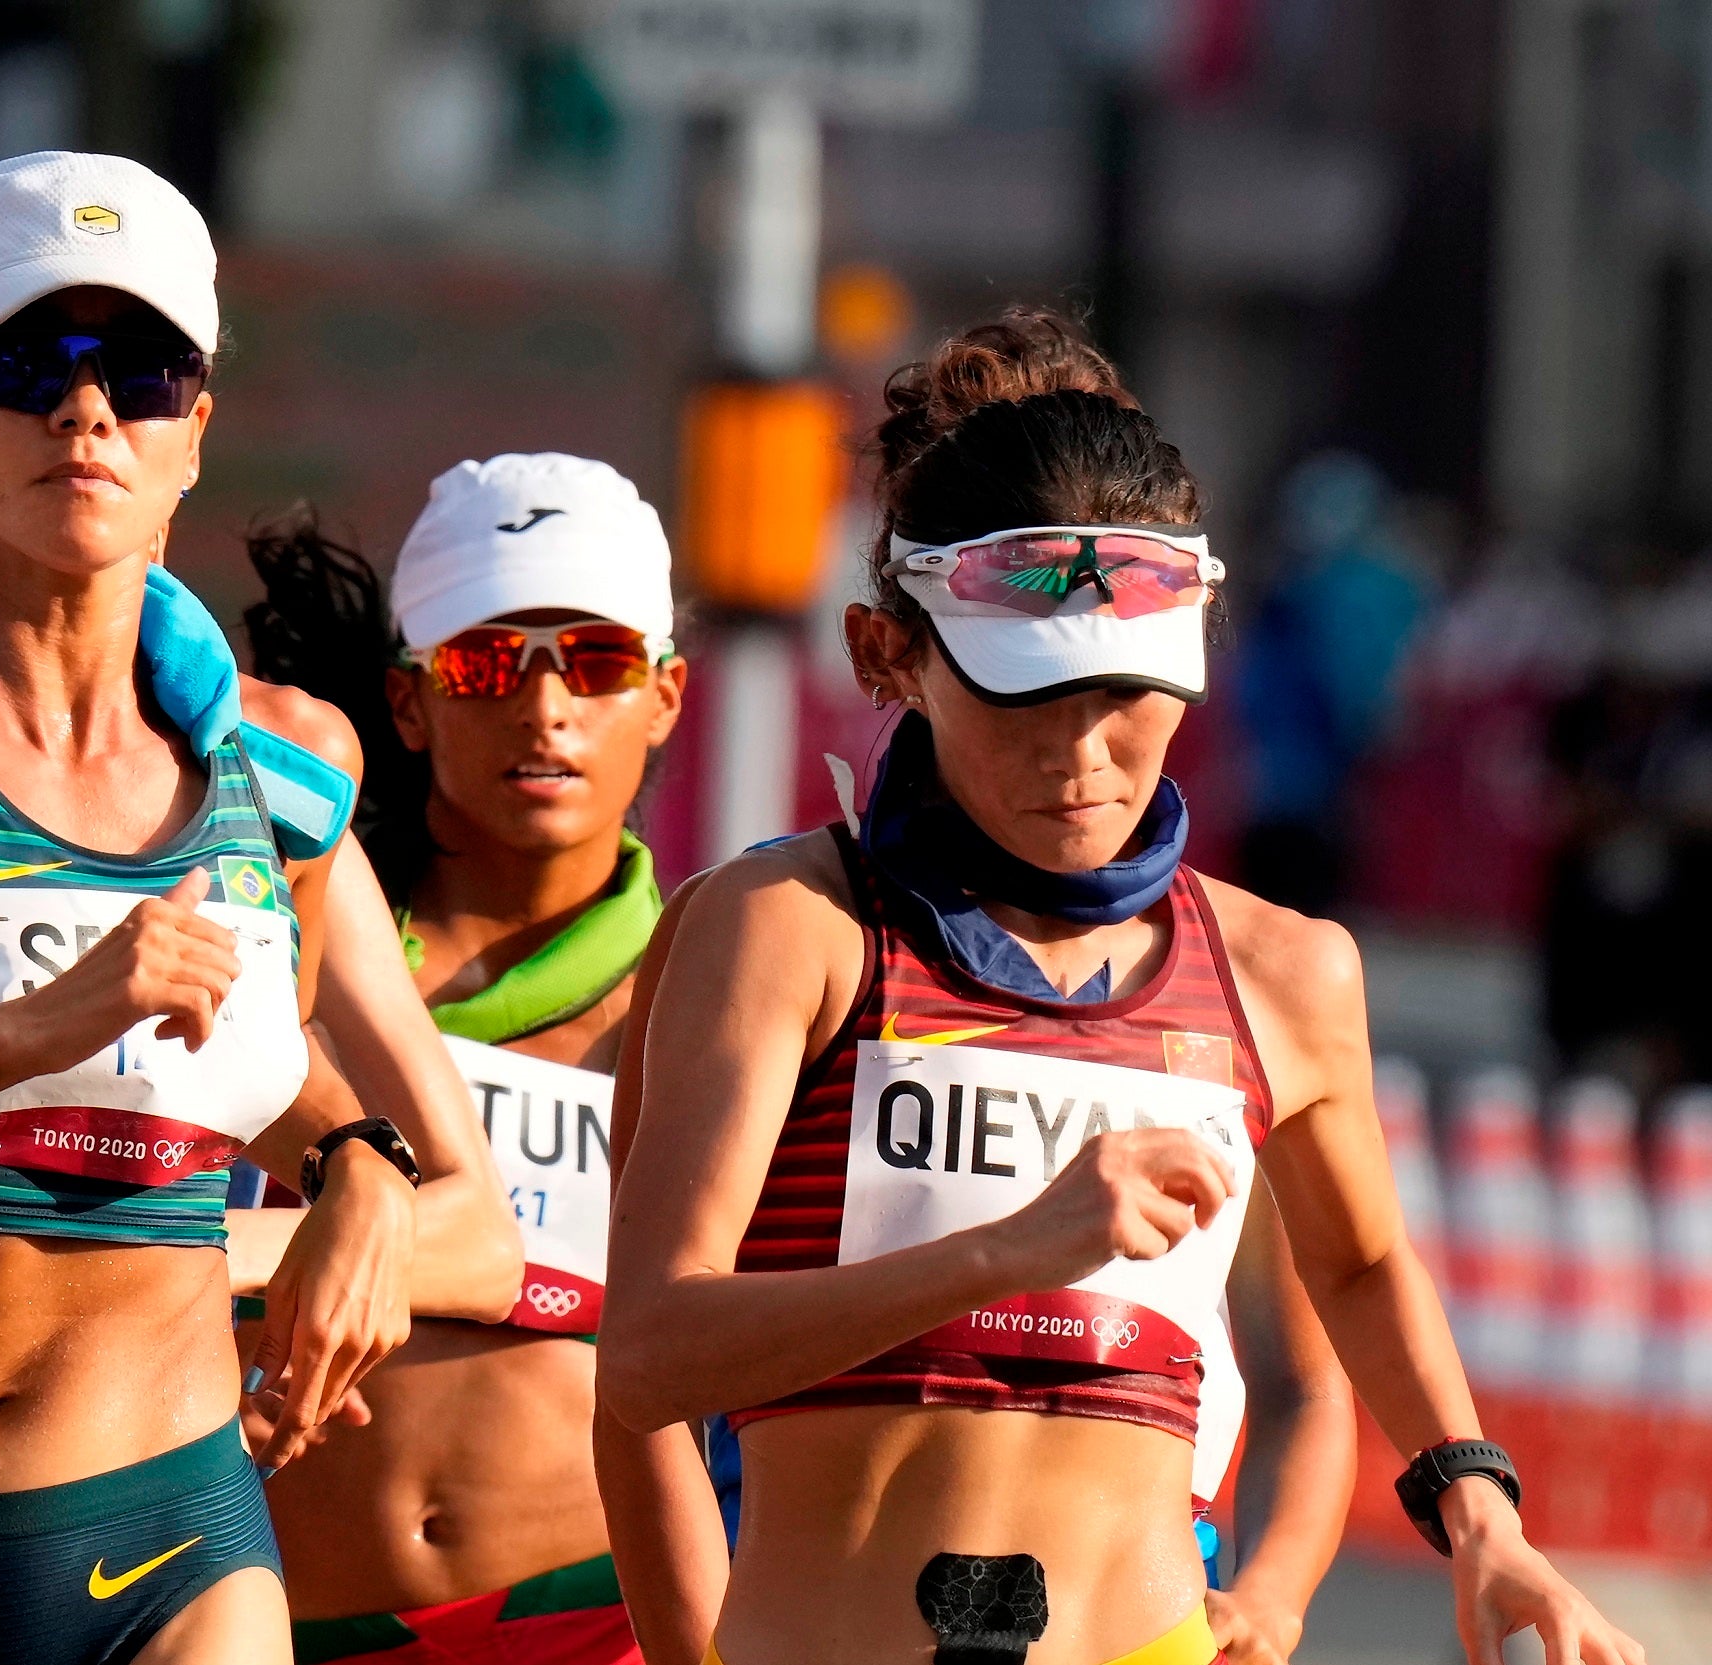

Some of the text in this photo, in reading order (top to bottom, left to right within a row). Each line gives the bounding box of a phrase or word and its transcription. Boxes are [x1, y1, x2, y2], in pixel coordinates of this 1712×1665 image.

[32, 1127, 147, 1160] TOKYO 2020
[969, 1310, 1085, 1338] TOKYO 2020
